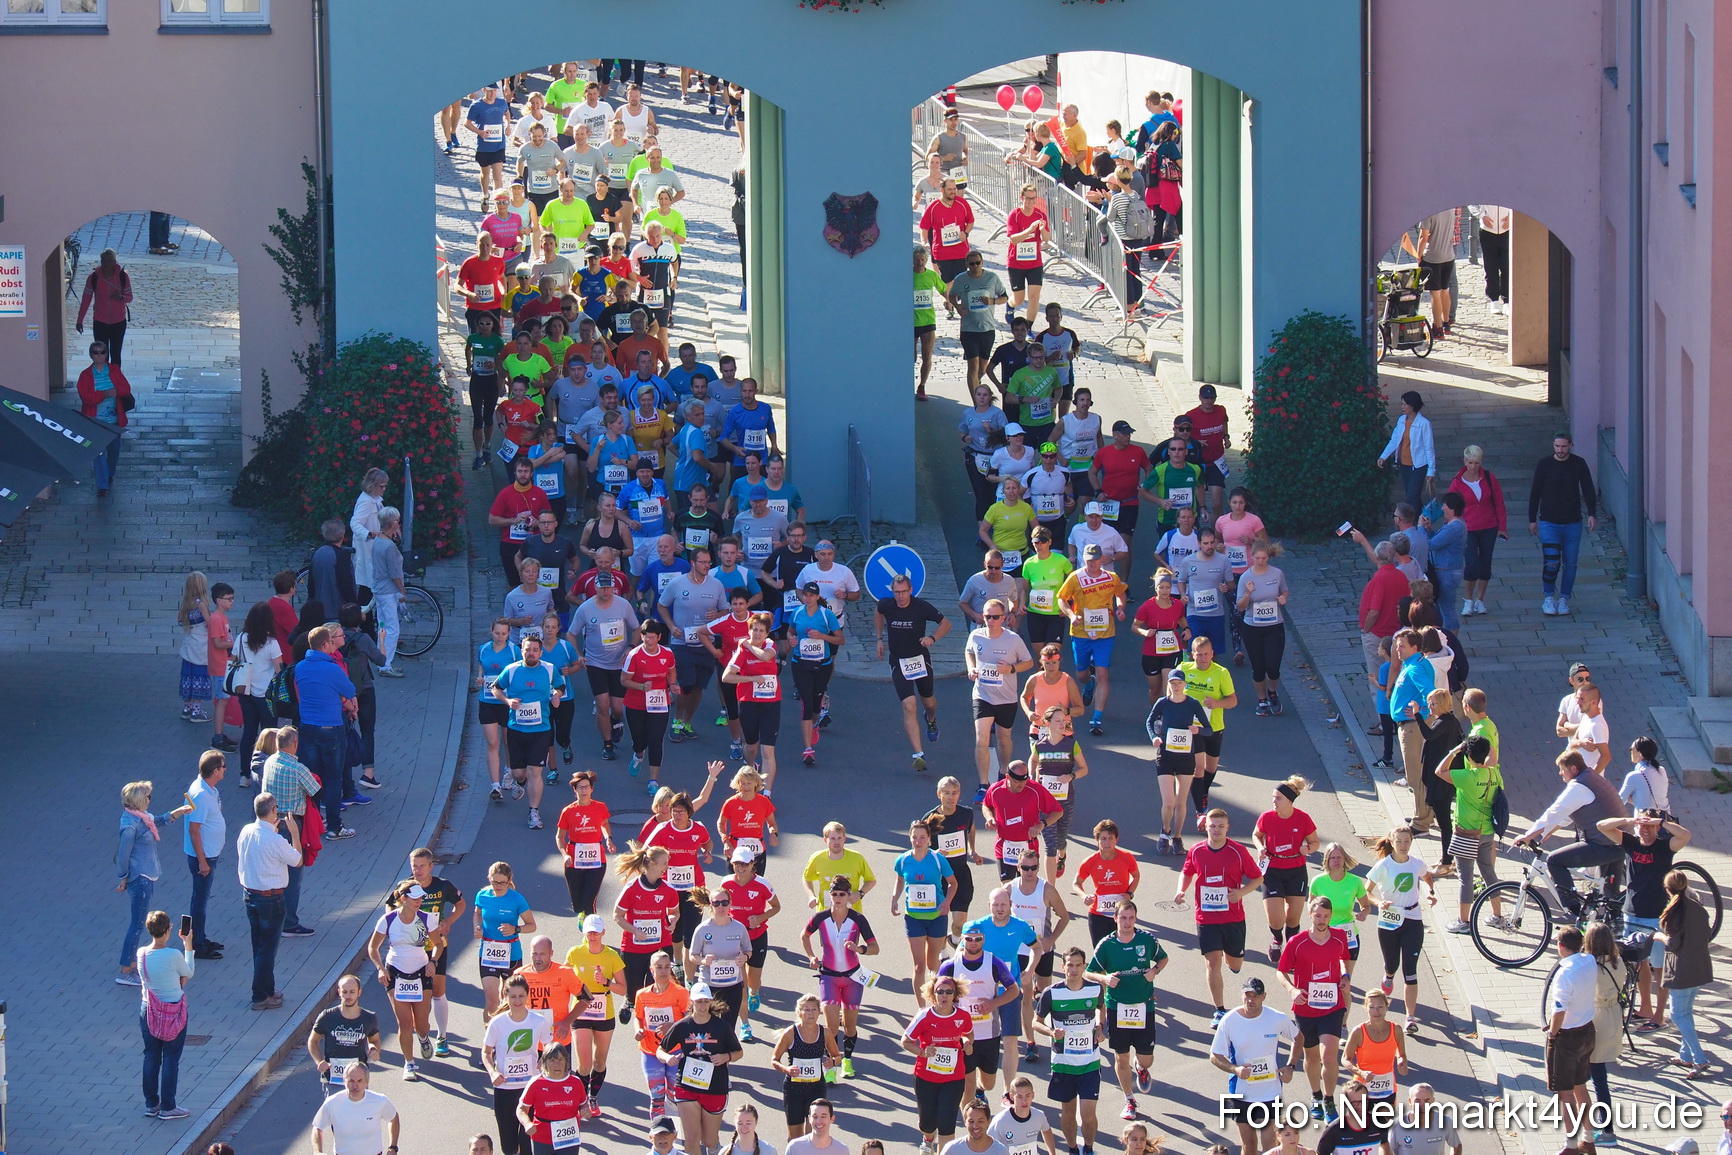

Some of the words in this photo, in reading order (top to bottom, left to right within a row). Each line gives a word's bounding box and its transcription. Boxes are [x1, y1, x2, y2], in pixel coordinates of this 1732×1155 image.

[576, 168, 590, 177] 2996
[944, 231, 958, 239] 2433
[646, 294, 661, 302] 2317
[1033, 402, 1049, 411] 2162
[748, 434, 763, 442] 3116
[608, 470, 625, 478] 2090
[539, 479, 555, 487] 2083
[642, 503, 659, 514] 3099
[692, 534, 701, 542] 87
[751, 543, 768, 551] 2092
[1228, 551, 1243, 559] 2485
[542, 573, 552, 581] 50
[1197, 595, 1215, 604] 2496
[1256, 608, 1274, 616] 2033
[1161, 637, 1175, 645] 265
[803, 644, 821, 652] 2086
[904, 661, 922, 671] 2325
[981, 669, 999, 677] 2190
[649, 696, 664, 704] 2311
[519, 708, 537, 717] 2084
[1172, 735, 1187, 743] 306
[1048, 782, 1063, 791] 287
[945, 838, 960, 849] 337
[578, 850, 598, 859] 2182
[671, 872, 692, 881] 2210
[916, 891, 927, 899] 81
[1204, 893, 1224, 901] 2447
[1382, 910, 1401, 922] 2260
[486, 948, 507, 958] 2482
[714, 966, 736, 976] 2559
[399, 983, 419, 991] 3006
[530, 987, 551, 998] RUN
[1312, 990, 1334, 999] 2446
[1124, 1008, 1139, 1017] 172
[649, 1014, 670, 1023] 2049
[1064, 1019, 1090, 1027] MAGNERS
[1068, 1037, 1089, 1046] 2120
[935, 1053, 951, 1064] 359
[508, 1063, 529, 1074] 2253
[692, 1067, 704, 1076] 97
[800, 1066, 815, 1075] 196
[1252, 1063, 1268, 1073] 234
[556, 1126, 577, 1138] 2368
